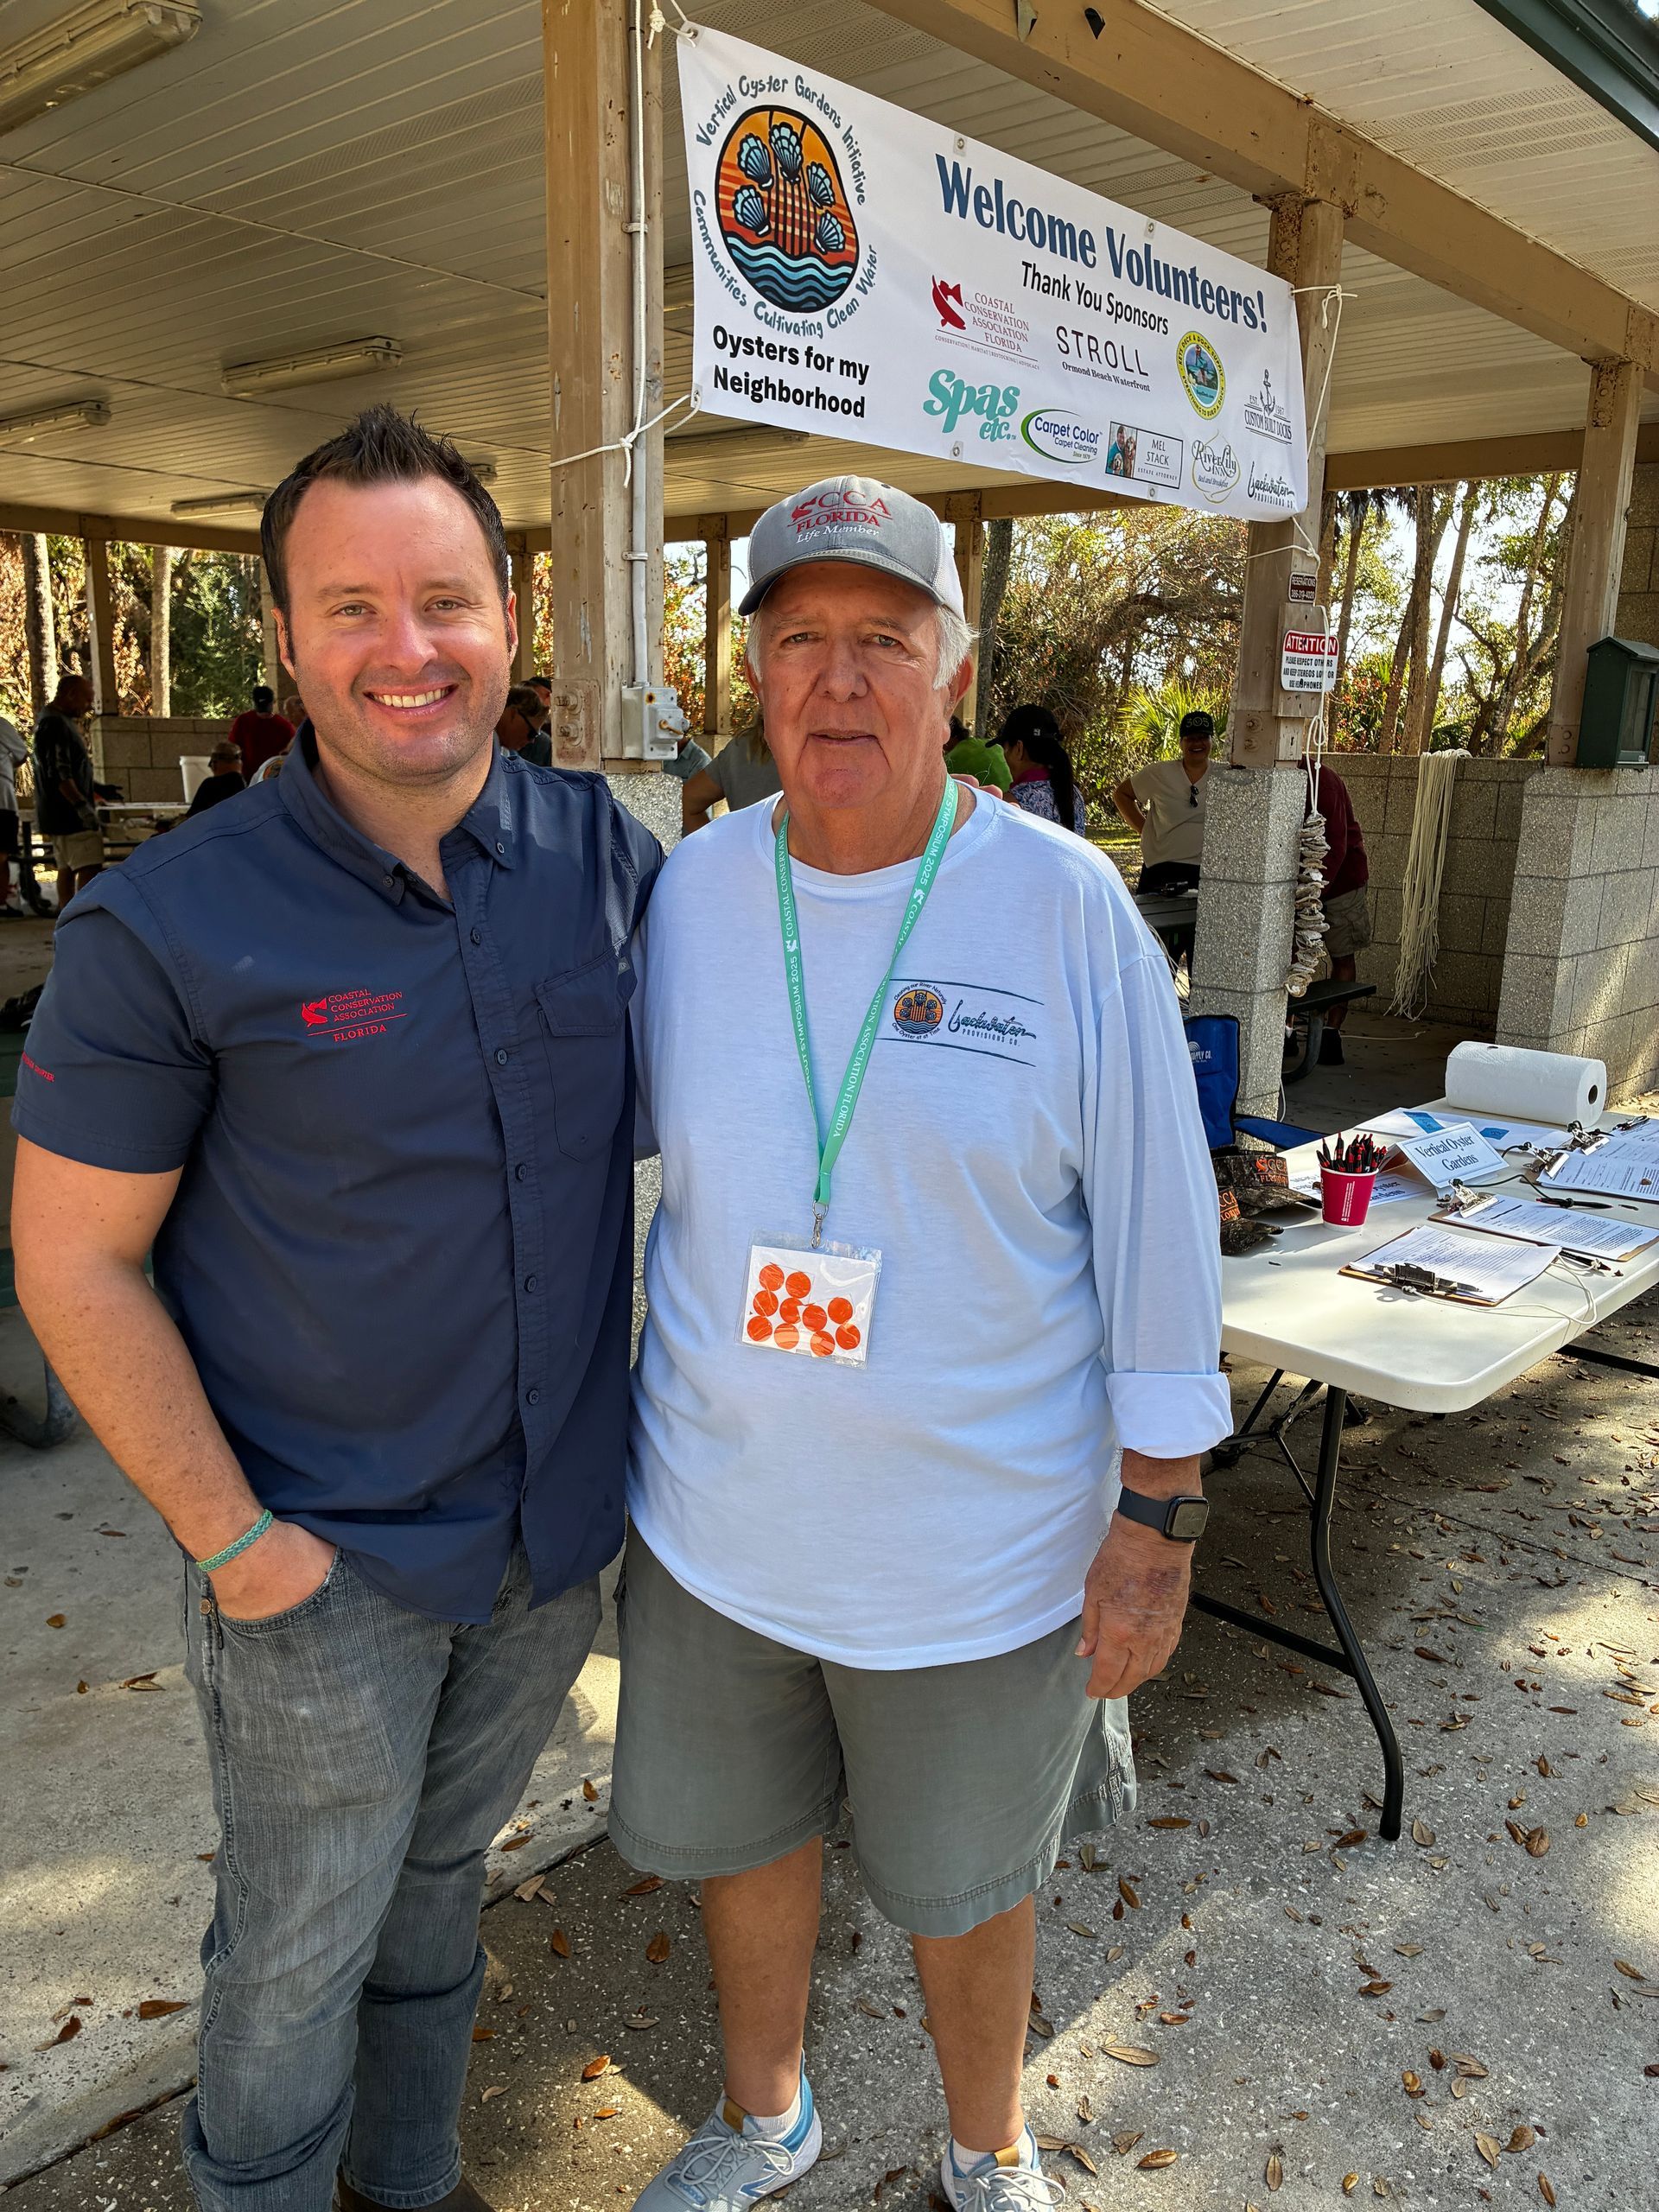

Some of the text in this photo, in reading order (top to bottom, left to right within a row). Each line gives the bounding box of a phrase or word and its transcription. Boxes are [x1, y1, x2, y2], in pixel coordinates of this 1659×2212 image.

[696, 74, 868, 206] Vertical Oyster Gardens Initiative
[935, 153, 1268, 334] Welcome Volunteers!
[693, 189, 879, 339] Communities Cultivating Clean Water
[975, 292, 1015, 314] COASTAL
[1021, 260, 1169, 335] Thank You Sponsors
[964, 301, 1029, 331] CONSERVATION
[972, 316, 1029, 343] ASSOCIATION
[713, 325, 870, 385] Oysters for my
[984, 333, 1023, 353] FLORIDA
[1056, 326, 1149, 377] STROLL
[1062, 361, 1151, 392] Ormond Beach Waterfront
[713, 365, 867, 418] Neighborhood
[923, 369, 1020, 434] Spas
[979, 417, 1011, 442] etc.
[1034, 416, 1100, 444] Carpet Color
[1244, 410, 1293, 440] CUSTOM BUILT DOCKS
[1054, 437, 1098, 455] Carpet Cleaning
[1147, 451, 1169, 466] STACK
[1152, 439, 1166, 452] MEL
[817, 490, 892, 516] CCA
[796, 512, 881, 534] FLORIDA
[796, 524, 880, 544] Life Member
[1297, 657, 1313, 666] RESPECT
[1314, 658, 1333, 667] OTHRS
[1297, 669, 1315, 677] STEREOS
[1327, 671, 1334, 679] OR
[929, 799, 953, 857] SYMPOSIUM
[779, 824, 788, 893] CONSERVATION
[919, 859, 935, 886] 2025
[783, 893, 794, 938] COASTAL
[899, 905, 918, 946] COASTAL
[790, 956, 798, 983] 2025
[328, 988, 372, 1003] COASTAL
[331, 991, 404, 1013] CONSERVATION
[334, 1003, 395, 1022] ASSOCIATION
[792, 986, 806, 1052] SYMPOSIUM
[334, 1024, 387, 1043] FLORIDA
[899, 1030, 916, 1039] Oyster
[930, 1027, 941, 1036] Time
[962, 1029, 1020, 1047] PROVISIONS CO.
[845, 1026, 872, 1092] ASSOCIATION
[833, 1092, 852, 1138] FLORIDA
[1414, 1135, 1475, 1159] Vertical Oyster
[1441, 1154, 1479, 1172] Gardens
